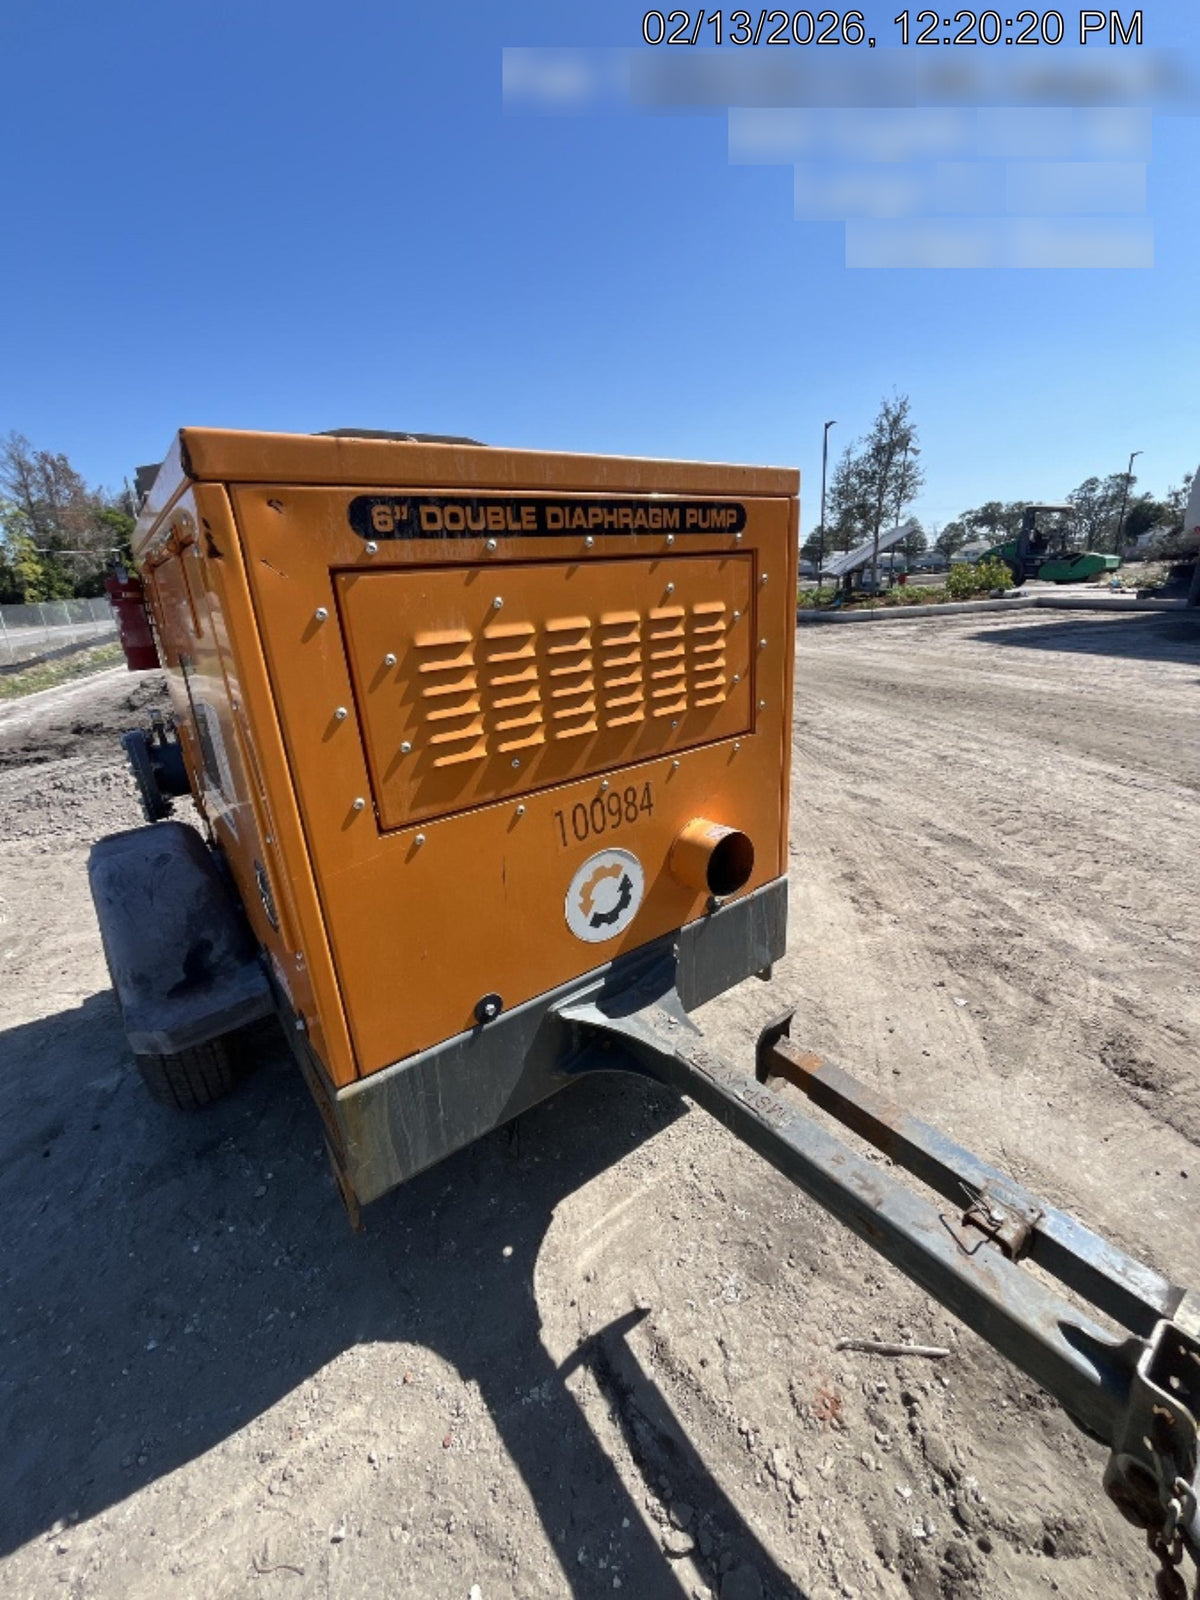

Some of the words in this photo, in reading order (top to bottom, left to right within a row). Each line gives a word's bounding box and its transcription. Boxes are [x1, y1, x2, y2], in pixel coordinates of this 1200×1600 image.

[419, 506, 537, 531] DOUBLE
[545, 506, 680, 530] DIAPHRAGM
[686, 508, 737, 528] PUMP
[554, 782, 653, 847] 100984
